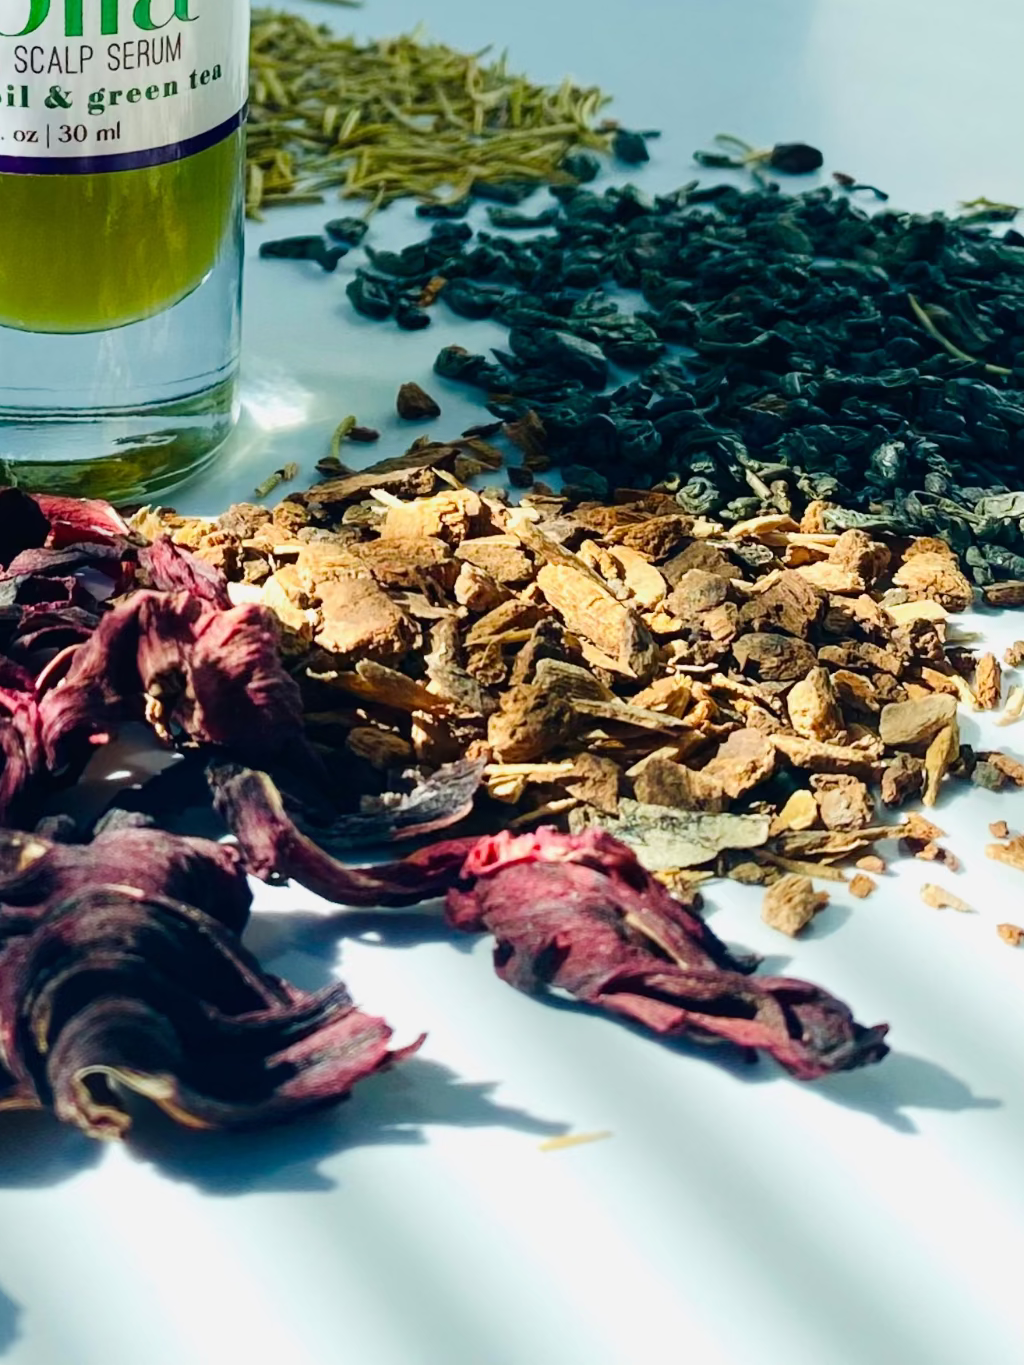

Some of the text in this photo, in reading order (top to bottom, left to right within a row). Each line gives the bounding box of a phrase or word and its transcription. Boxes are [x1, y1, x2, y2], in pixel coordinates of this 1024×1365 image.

[14, 45, 94, 74] SCALP
[107, 32, 182, 71] SERUM
[44, 85, 73, 109] &
[87, 79, 179, 116] green
[188, 64, 222, 90] tea
[13, 130, 39, 143] oz
[57, 124, 88, 143] 30
[96, 121, 121, 141] ml
